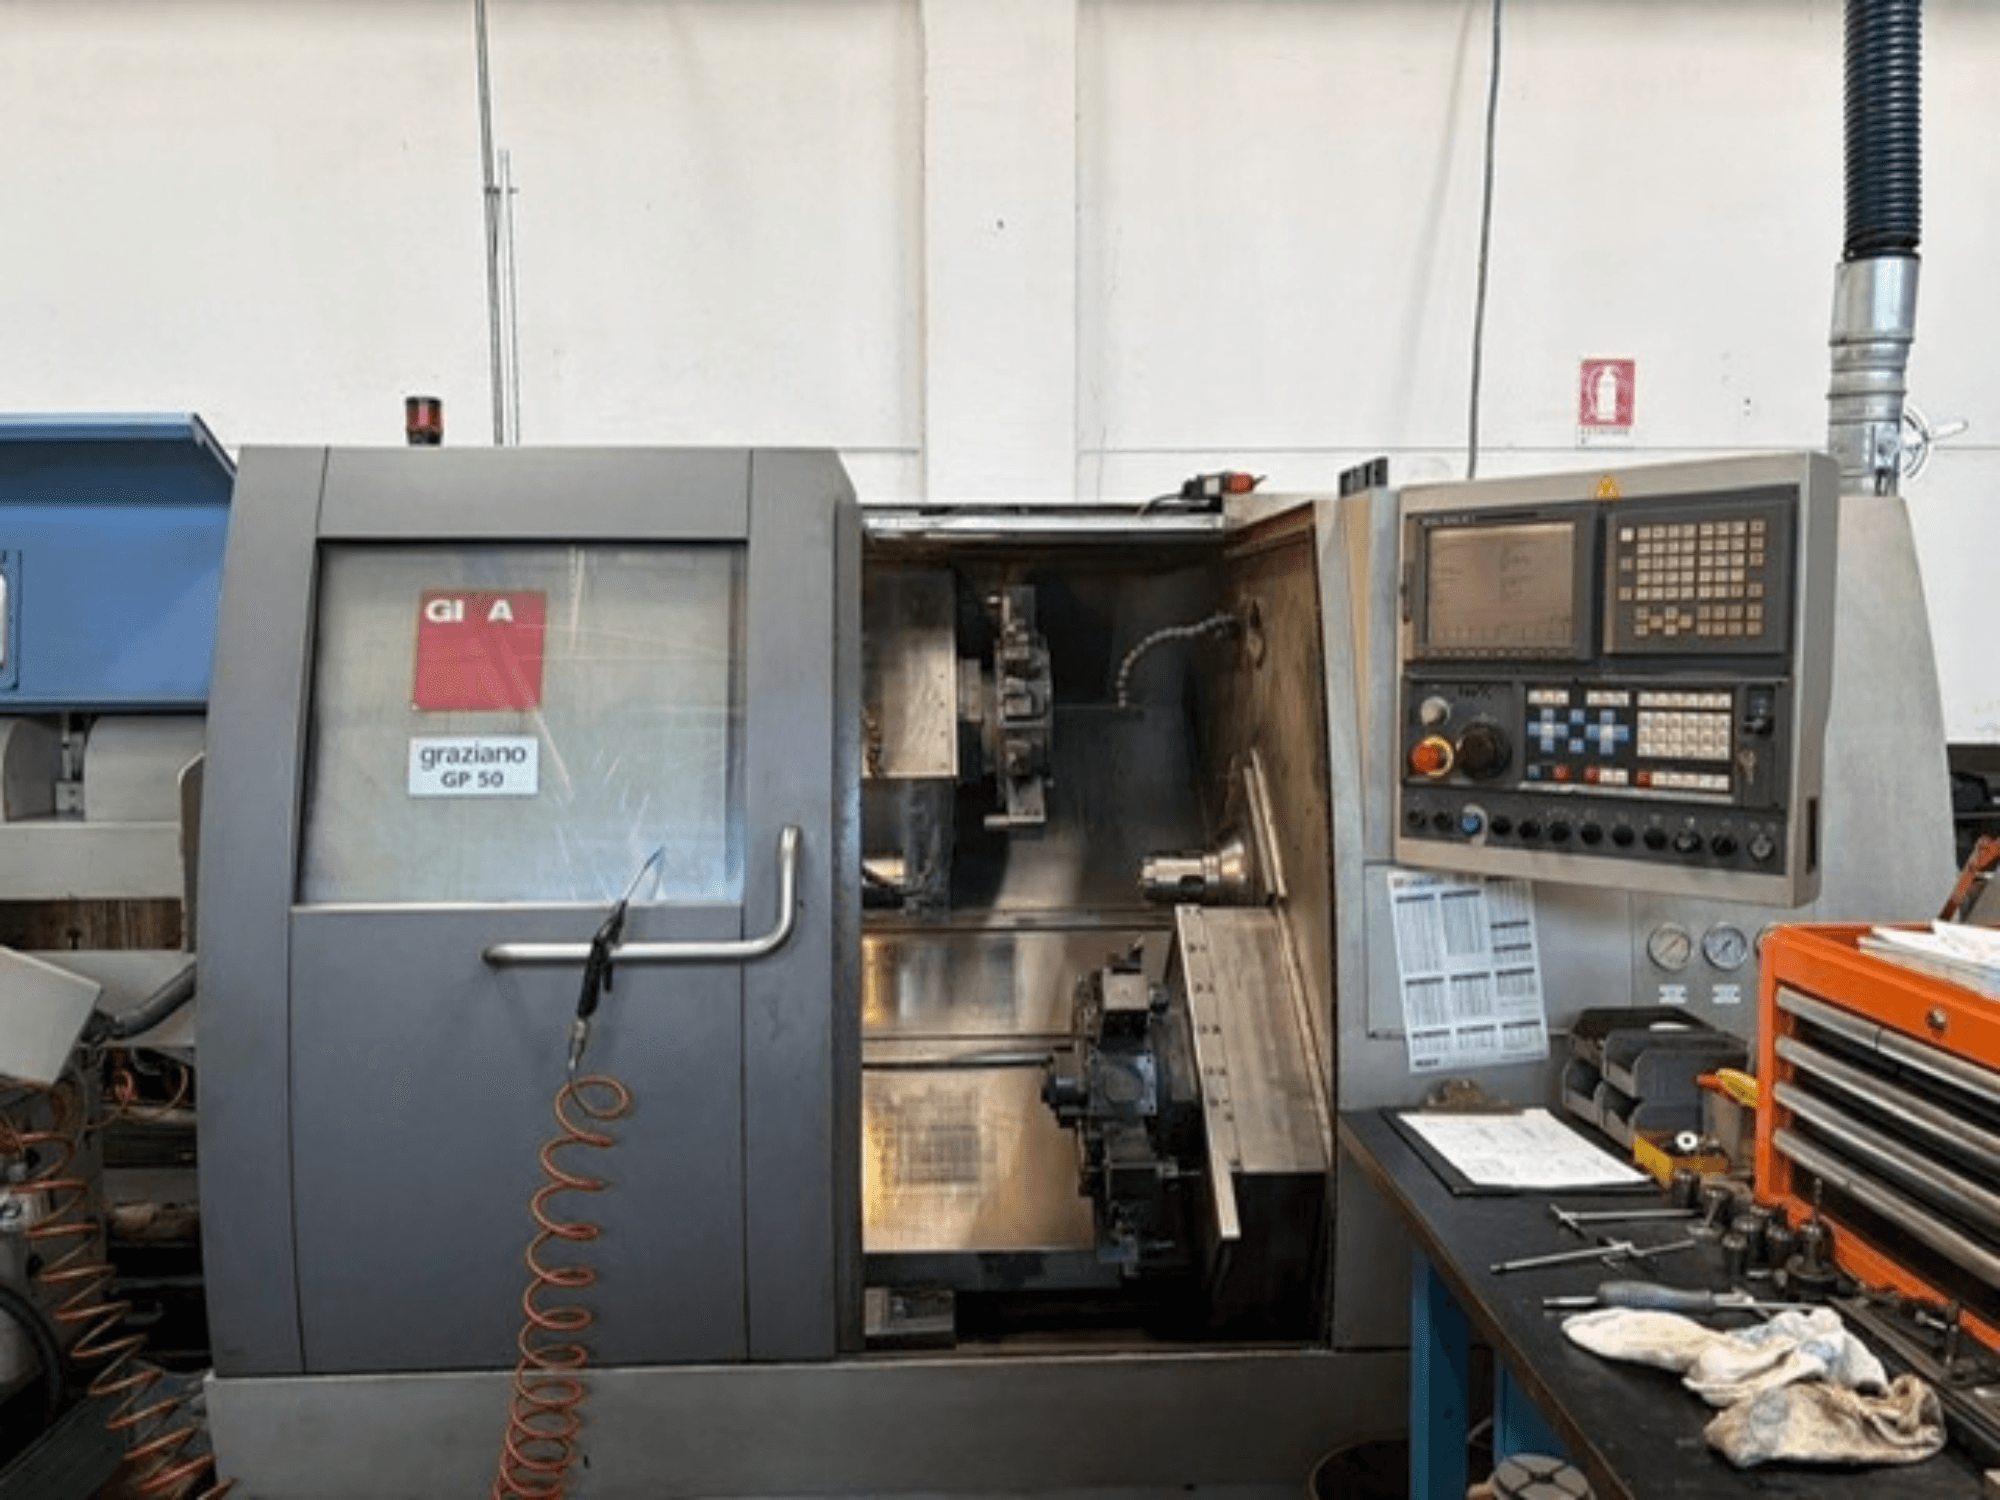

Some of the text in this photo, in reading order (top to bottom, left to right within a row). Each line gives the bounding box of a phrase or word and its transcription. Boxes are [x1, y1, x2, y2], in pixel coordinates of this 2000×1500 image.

[420, 741, 527, 771] graziano
[440, 771, 505, 788] GP 50
